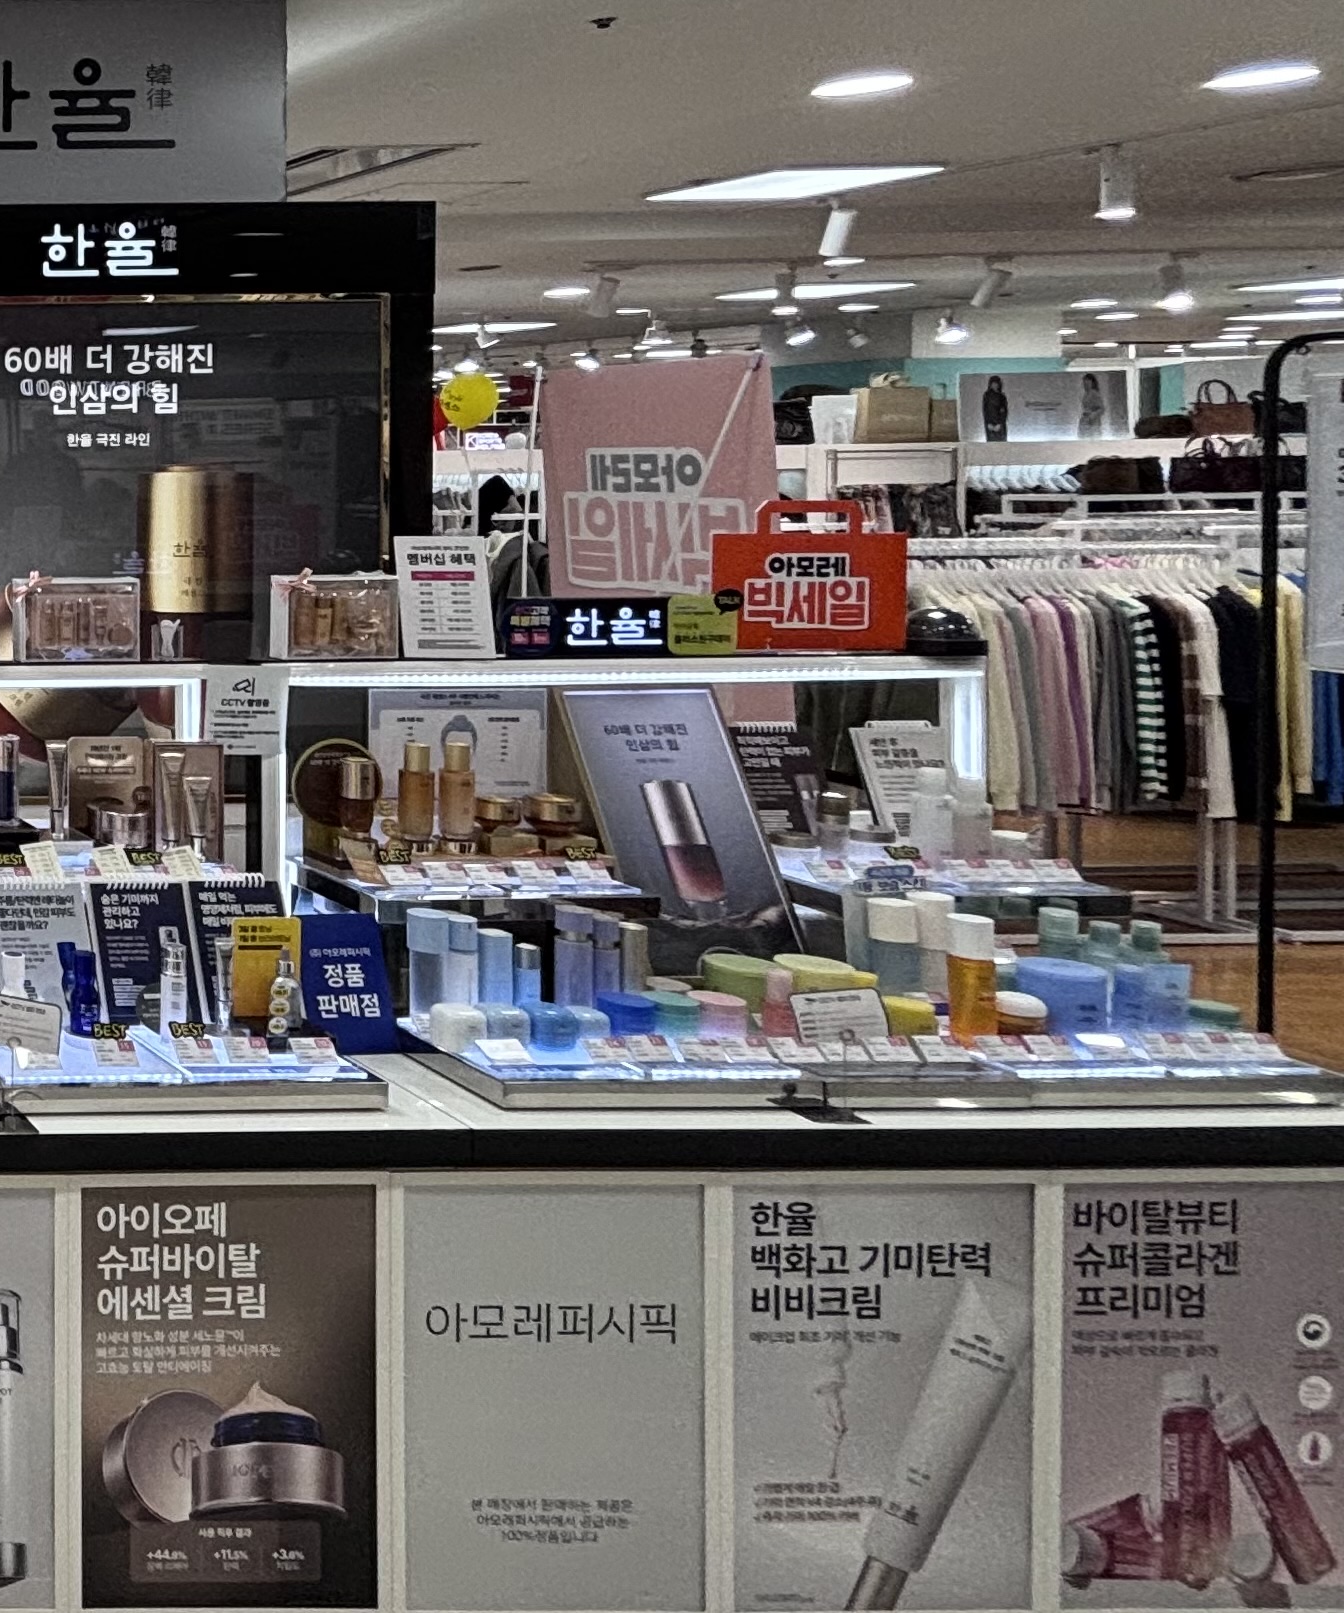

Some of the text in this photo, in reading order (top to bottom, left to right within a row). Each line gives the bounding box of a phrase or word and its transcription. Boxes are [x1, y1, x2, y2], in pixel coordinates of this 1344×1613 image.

[40, 221, 180, 277] 한율
[4, 343, 214, 375] 60배 더 강해진
[48, 383, 178, 416] 인삼의 힘
[125, 432, 150, 447] 라인
[406, 552, 477, 567] 멤버십 혜택
[768, 556, 847, 577] 아모레
[745, 578, 868, 627] 빅세일
[565, 607, 663, 646] 한율
[220, 698, 246, 707] CCTV
[635, 723, 648, 735] 더
[132, 850, 163, 864] BEST
[379, 849, 411, 864] BEST
[567, 846, 598, 860] BEST
[120, 894, 159, 905] 기미까지
[104, 918, 140, 930] 있나요?
[322, 947, 372, 958] 아모레퍼시픽
[322, 962, 365, 989] 정품
[316, 992, 381, 1020] 판매점
[93, 1023, 127, 1039] BEST
[171, 1022, 206, 1038] BEST
[96, 1201, 227, 1239] 아이오페
[749, 1201, 816, 1238] 한율
[1072, 1198, 1239, 1236] 바이탈뷰티
[96, 1243, 261, 1281] 슈퍼바이탈
[750, 1241, 992, 1279] 백화고 기미탄력
[1072, 1240, 1241, 1278] 슈퍼콜라겐
[96, 1283, 267, 1321] 에센셜 크림
[750, 1284, 882, 1321] 비비크림
[1072, 1283, 1206, 1319] 프리미엄
[424, 1302, 677, 1344] 아모레퍼시픽
